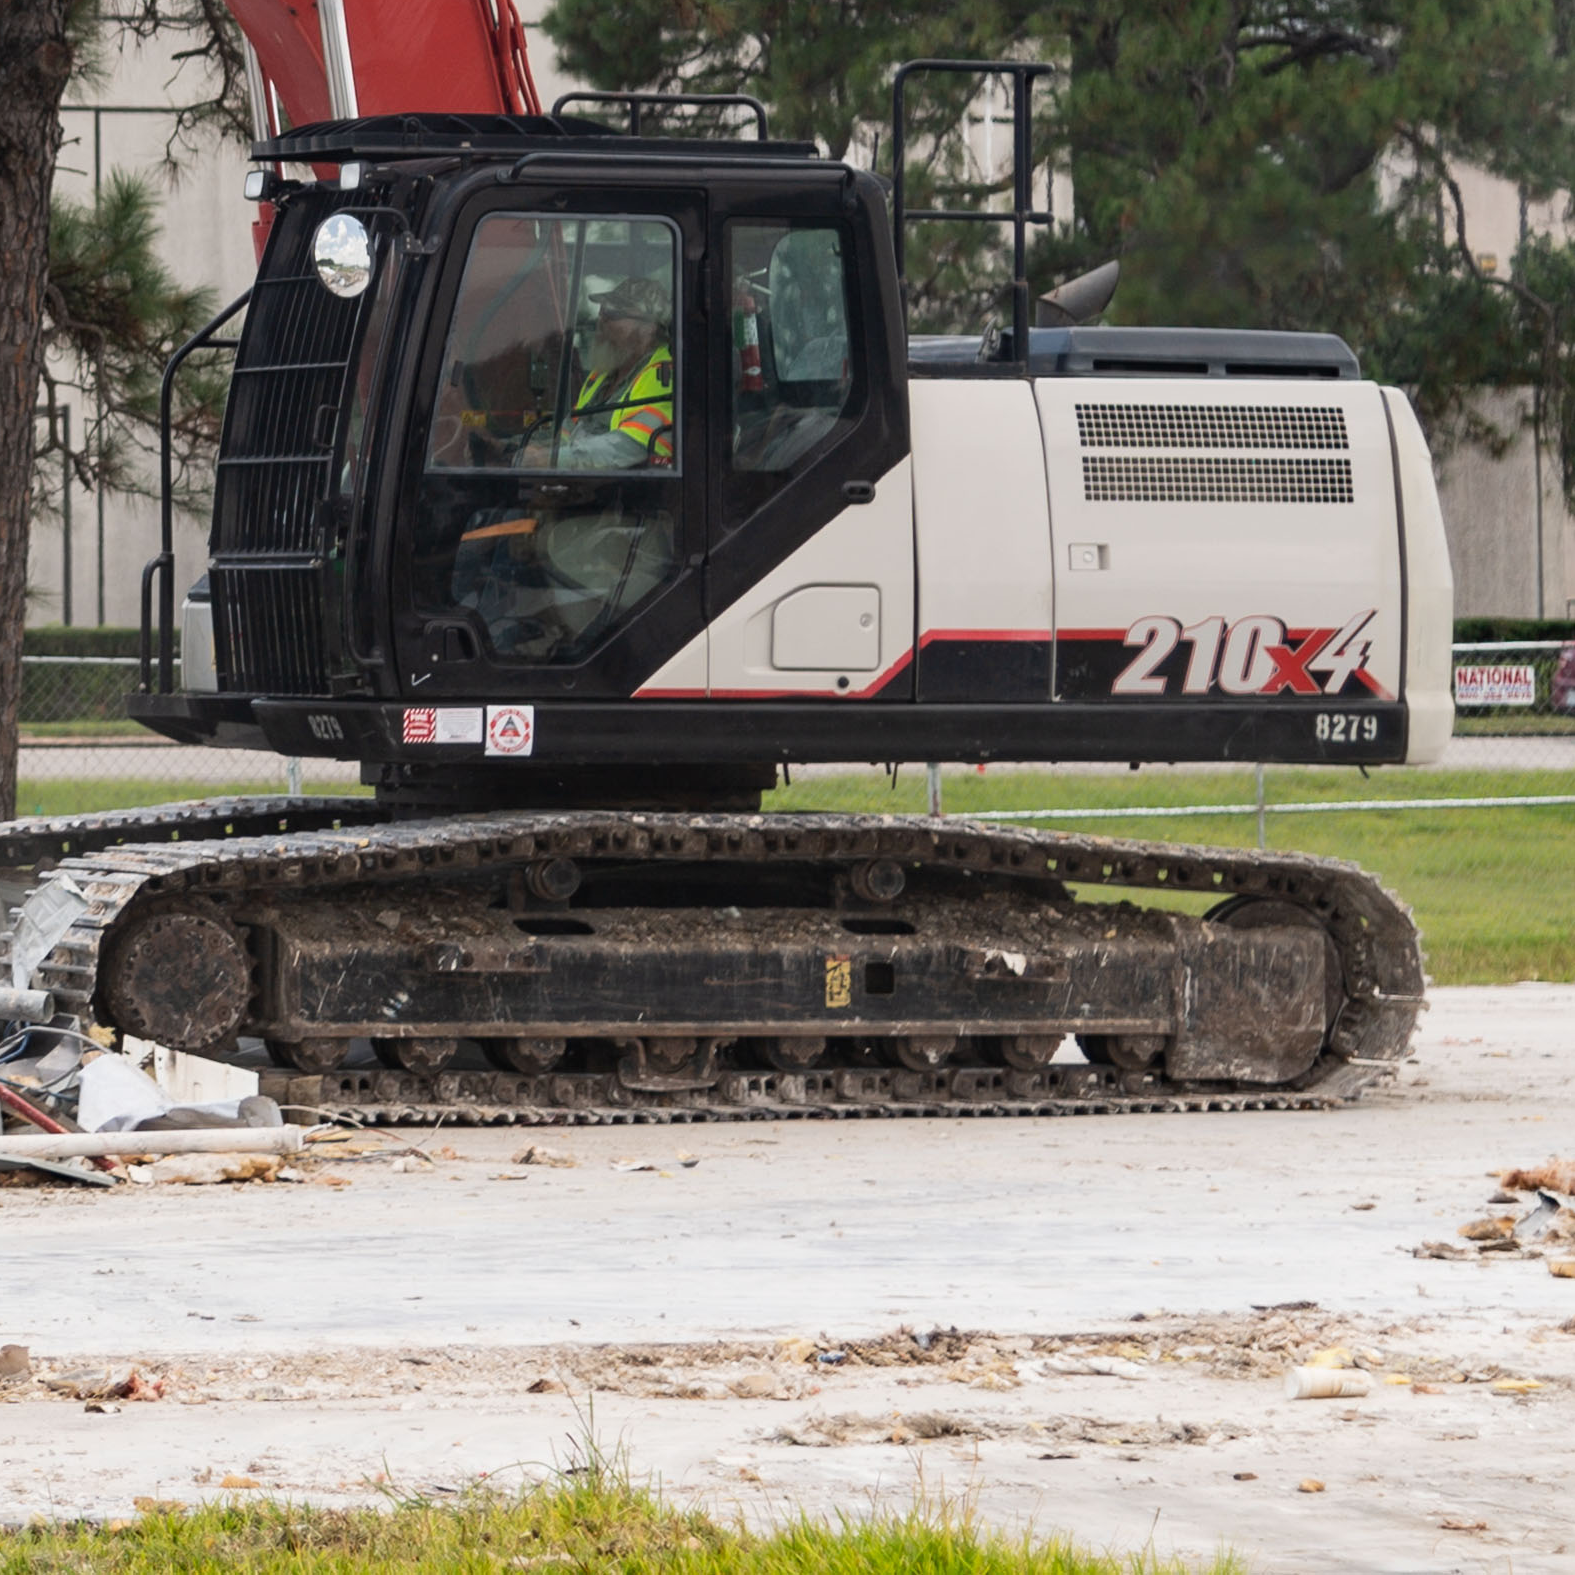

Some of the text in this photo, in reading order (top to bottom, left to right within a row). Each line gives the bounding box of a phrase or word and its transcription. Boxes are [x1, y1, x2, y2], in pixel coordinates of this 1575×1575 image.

[1457, 666, 1531, 686] NATIONAL
[308, 714, 344, 739] 8279
[1315, 713, 1378, 742] 8279
